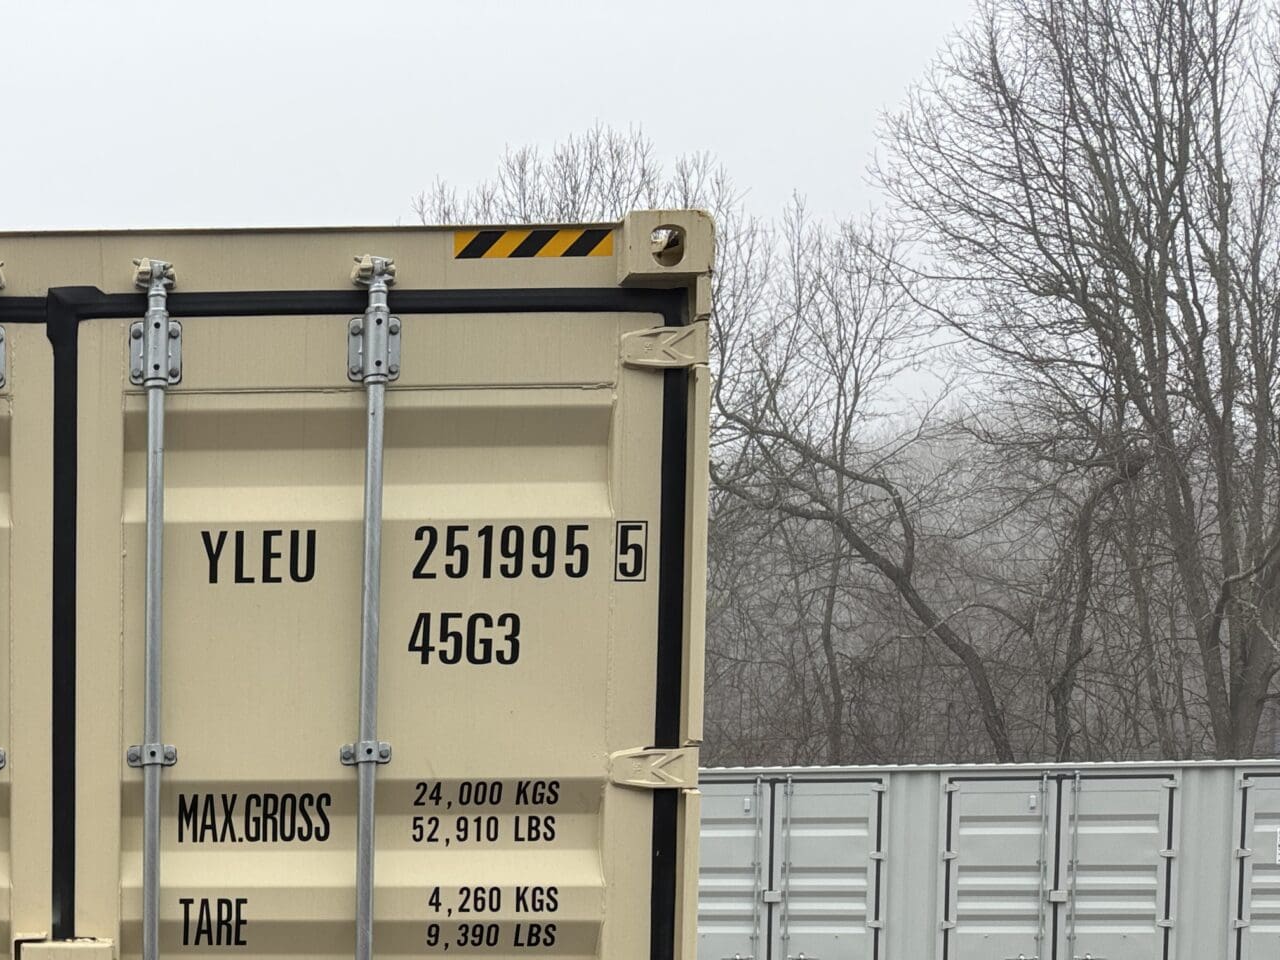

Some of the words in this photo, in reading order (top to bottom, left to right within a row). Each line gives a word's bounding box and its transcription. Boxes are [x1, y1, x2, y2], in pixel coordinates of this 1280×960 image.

[201, 529, 316, 584] YLEU
[412, 524, 590, 579] 251995
[618, 524, 644, 578] 5
[407, 612, 521, 665] 45G3
[413, 780, 503, 809] 24,000
[515, 780, 561, 807] KGS
[177, 792, 332, 843] MAX.GROSS
[412, 815, 499, 845] 52,910
[514, 815, 557, 842] LBS
[428, 886, 502, 917] 4,260
[515, 886, 560, 913] KGS
[179, 897, 248, 947] TARE
[426, 923, 500, 951] 9,390
[513, 923, 557, 948] LBS
